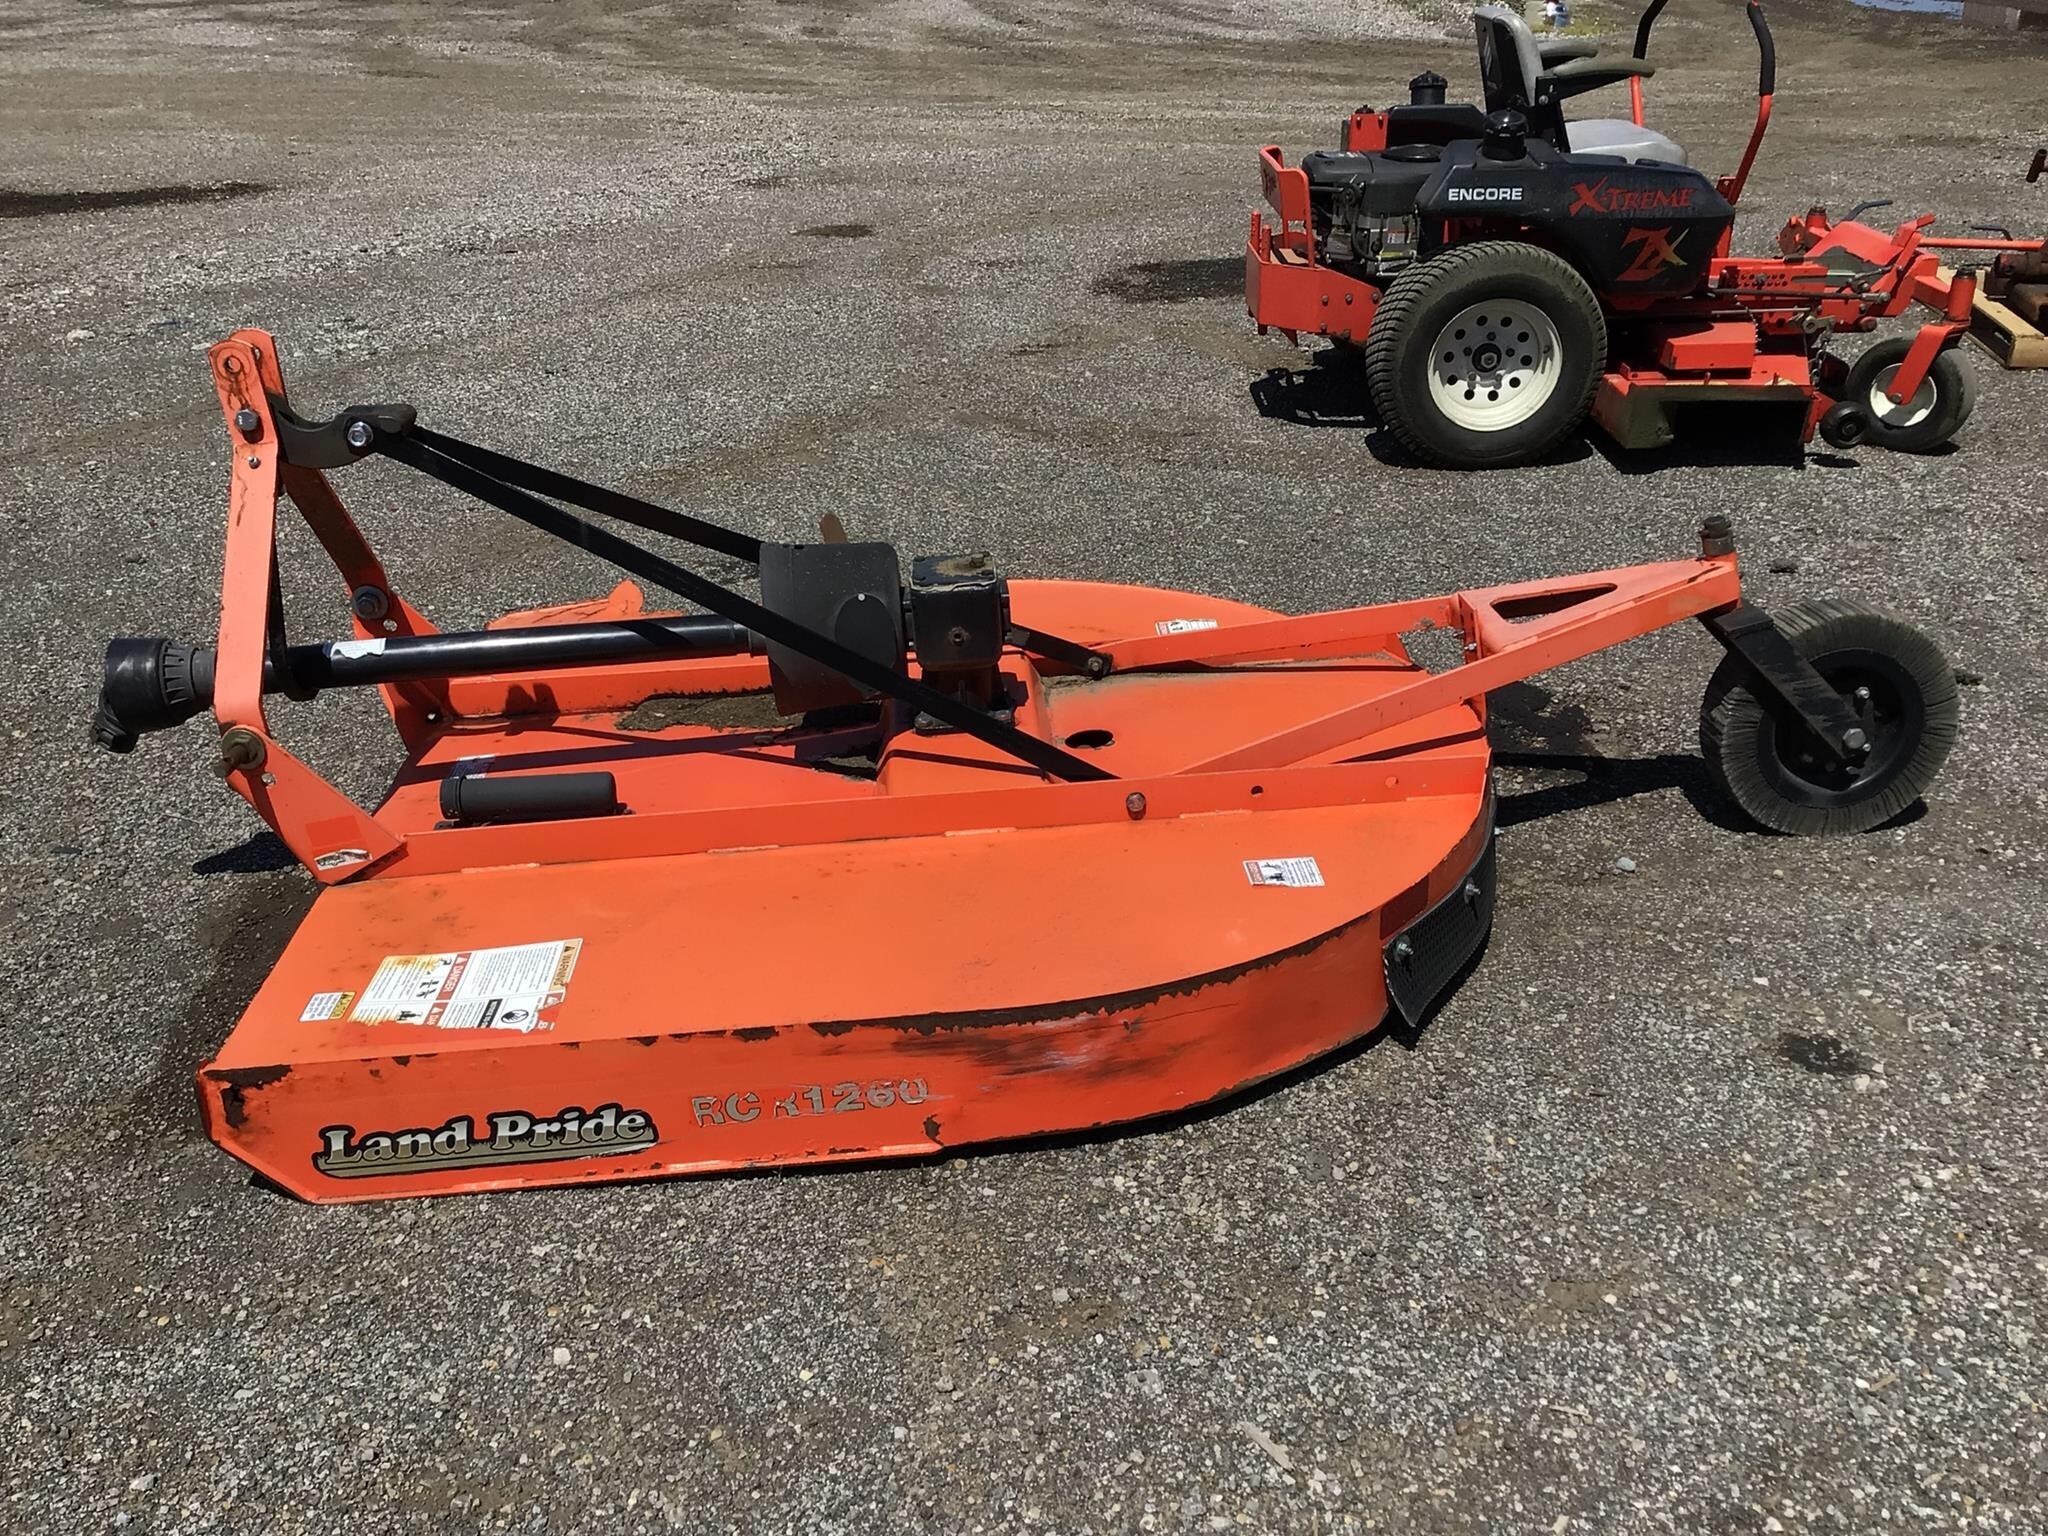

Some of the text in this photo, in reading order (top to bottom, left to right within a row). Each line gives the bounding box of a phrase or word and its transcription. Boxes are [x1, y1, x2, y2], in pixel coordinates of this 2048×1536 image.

[1448, 187, 1523, 201] ENCORE
[443, 965, 463, 993] DANGER
[553, 955, 572, 987] WARNING
[322, 1105, 652, 1167] Land Pride
